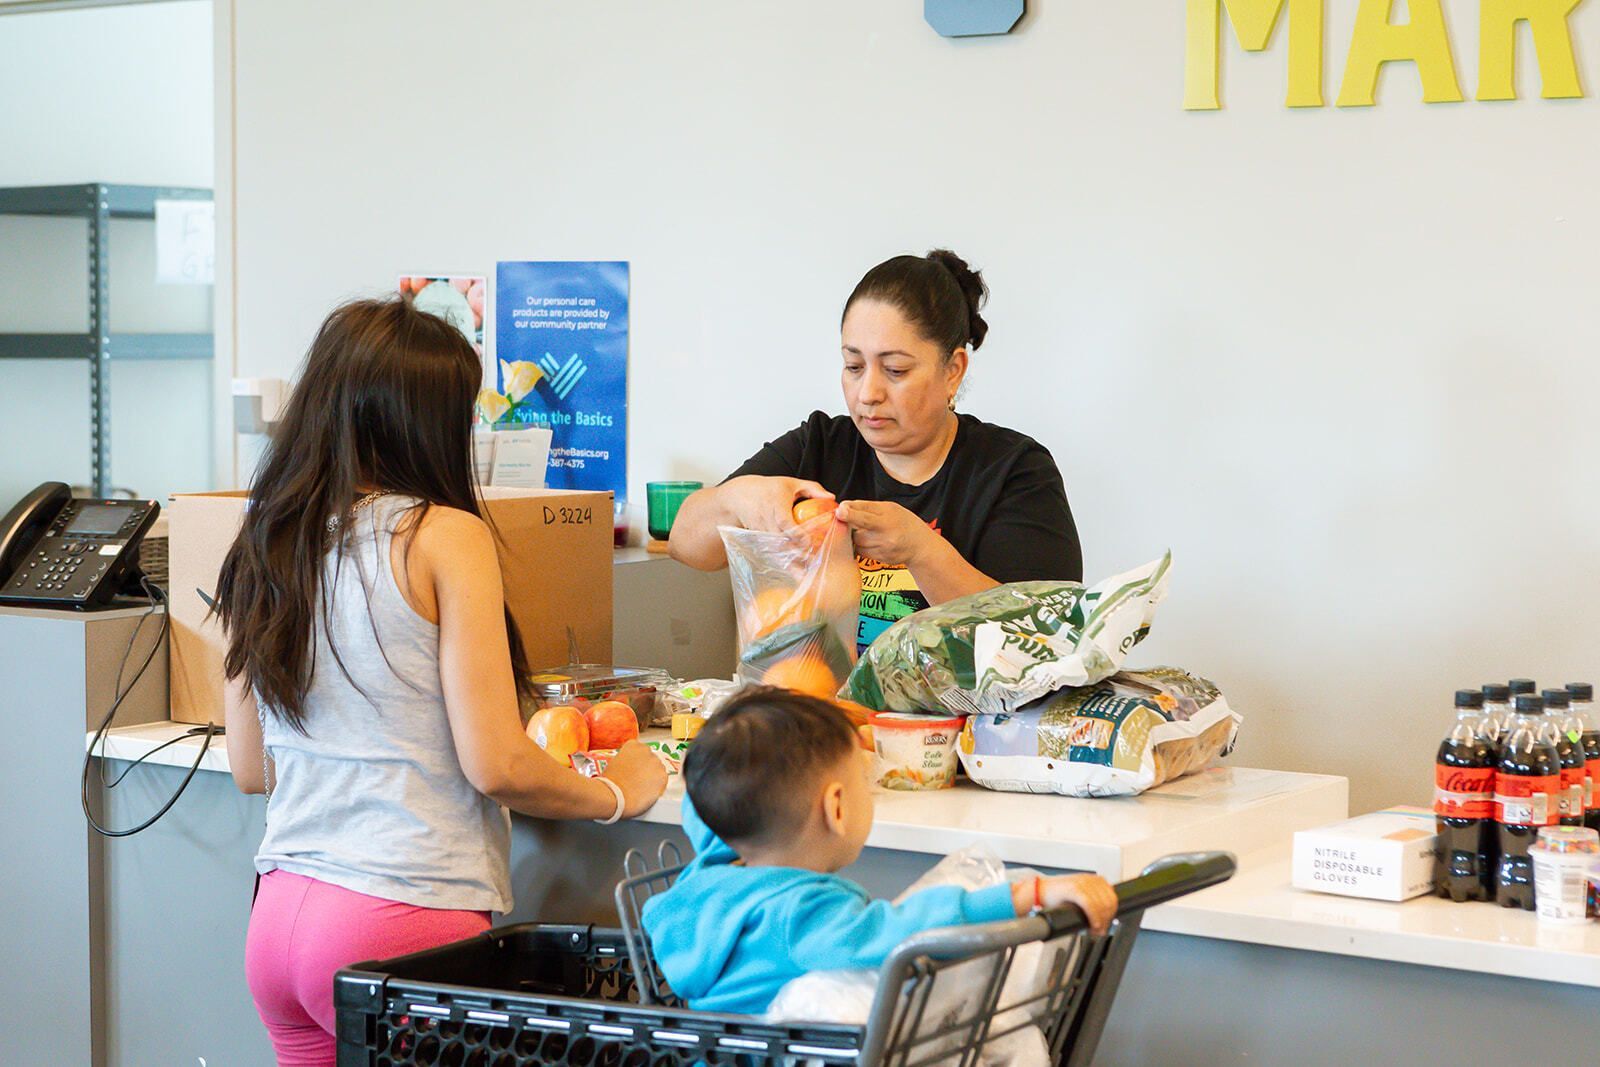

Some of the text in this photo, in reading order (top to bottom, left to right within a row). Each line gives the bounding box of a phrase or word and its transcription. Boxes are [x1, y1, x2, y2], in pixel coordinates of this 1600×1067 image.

[526, 296, 596, 307] Our personal care
[512, 308, 610, 320] products are provided by
[514, 319, 607, 331] our community partner
[512, 408, 614, 427] iving the Basics
[548, 447, 610, 460] ngtheBasics.org
[547, 458, 585, 469] -387-4375
[543, 506, 592, 525] D 3224
[861, 573, 894, 588] ALITY
[1315, 847, 1356, 860] NITRILE
[1313, 859, 1384, 876] DISPOSABLE
[1313, 871, 1357, 885] GLOVES
